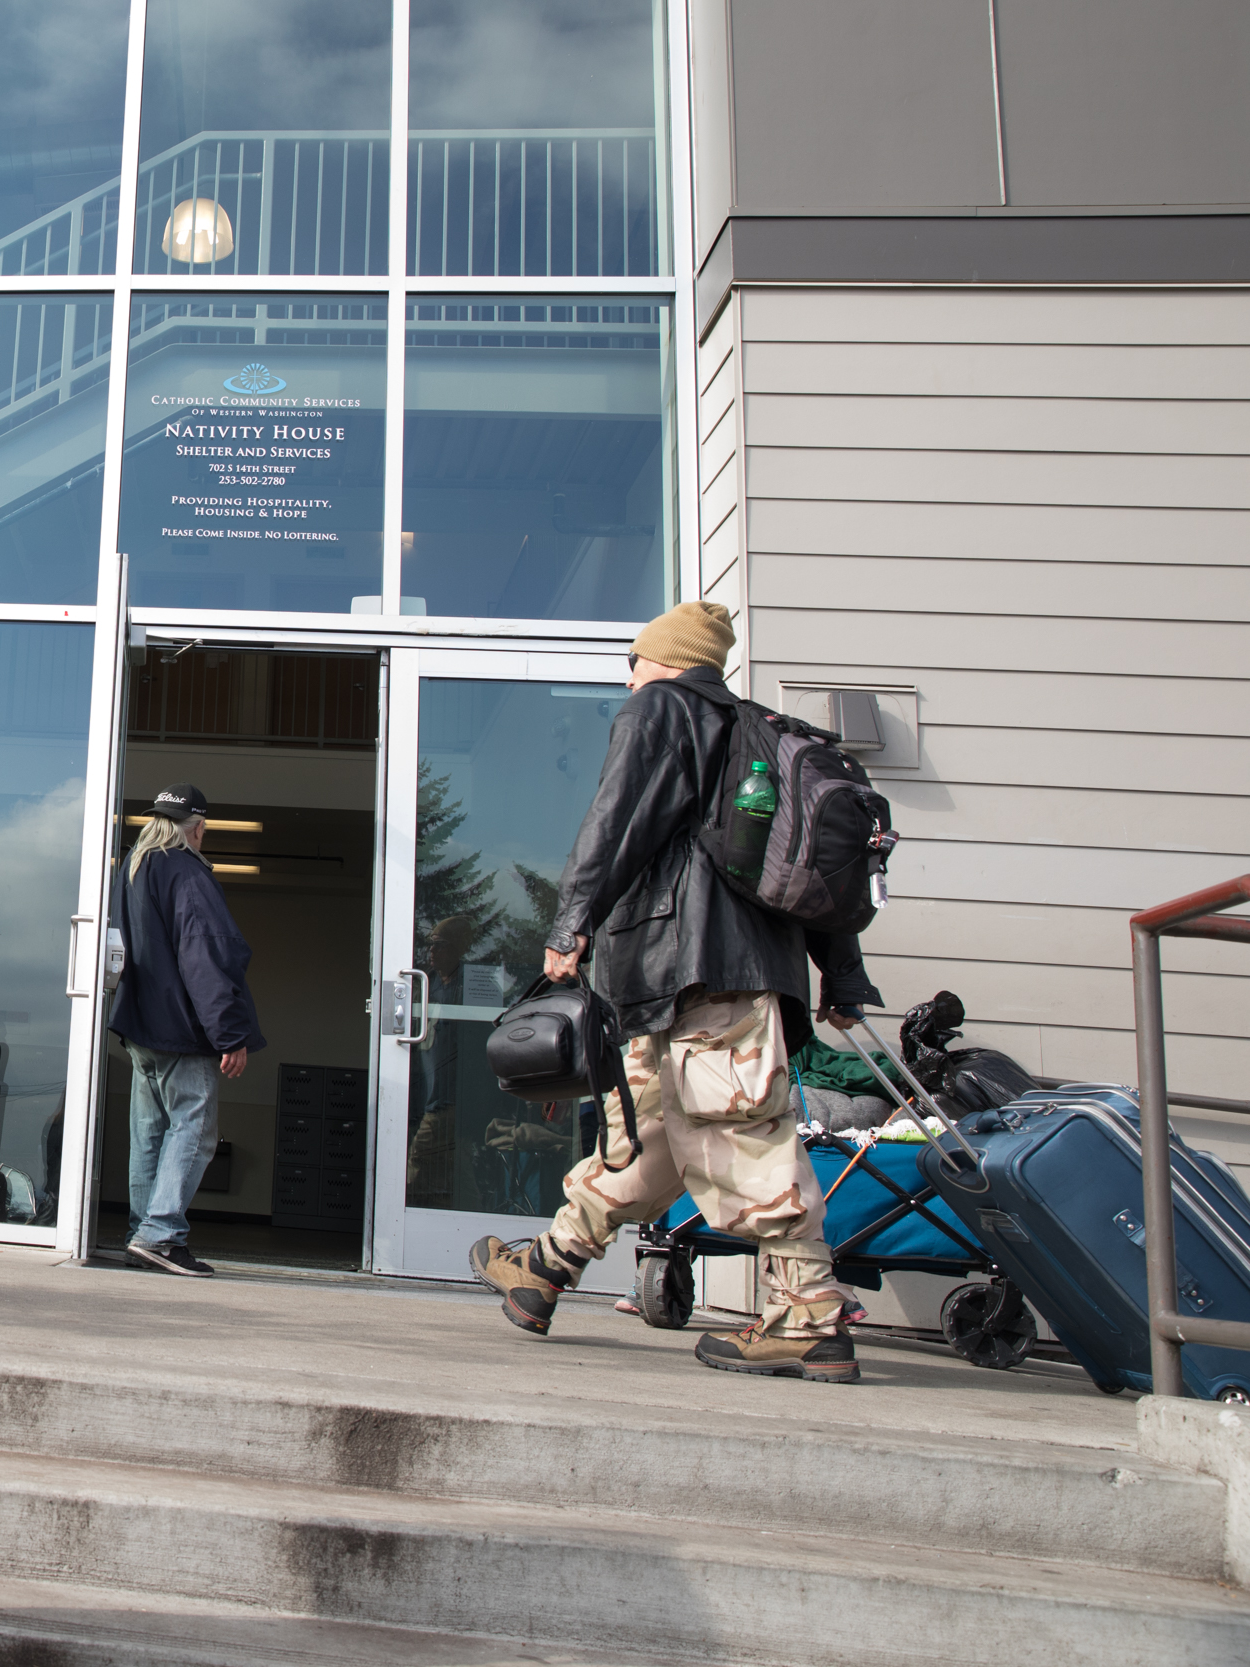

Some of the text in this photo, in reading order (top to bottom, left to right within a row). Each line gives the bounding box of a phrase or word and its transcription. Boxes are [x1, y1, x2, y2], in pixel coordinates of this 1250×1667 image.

[151, 395, 361, 408] CATHOLIC COMMUNITY SERVICES
[192, 408, 323, 418] OF WESTERN WASHINGTON
[165, 423, 346, 441] NATIVITY HOUSE
[176, 445, 331, 459] SHELTER AND SERVICES
[208, 464, 296, 475] 702 S 14TH STREET
[218, 476, 286, 486] 253-502-2780
[171, 496, 332, 509] PROVIDING HOSPITALITY,
[195, 507, 308, 519] HOUSING & HOPE
[162, 528, 339, 541] PLEASE COME INSIDE. NO LOITERING.
